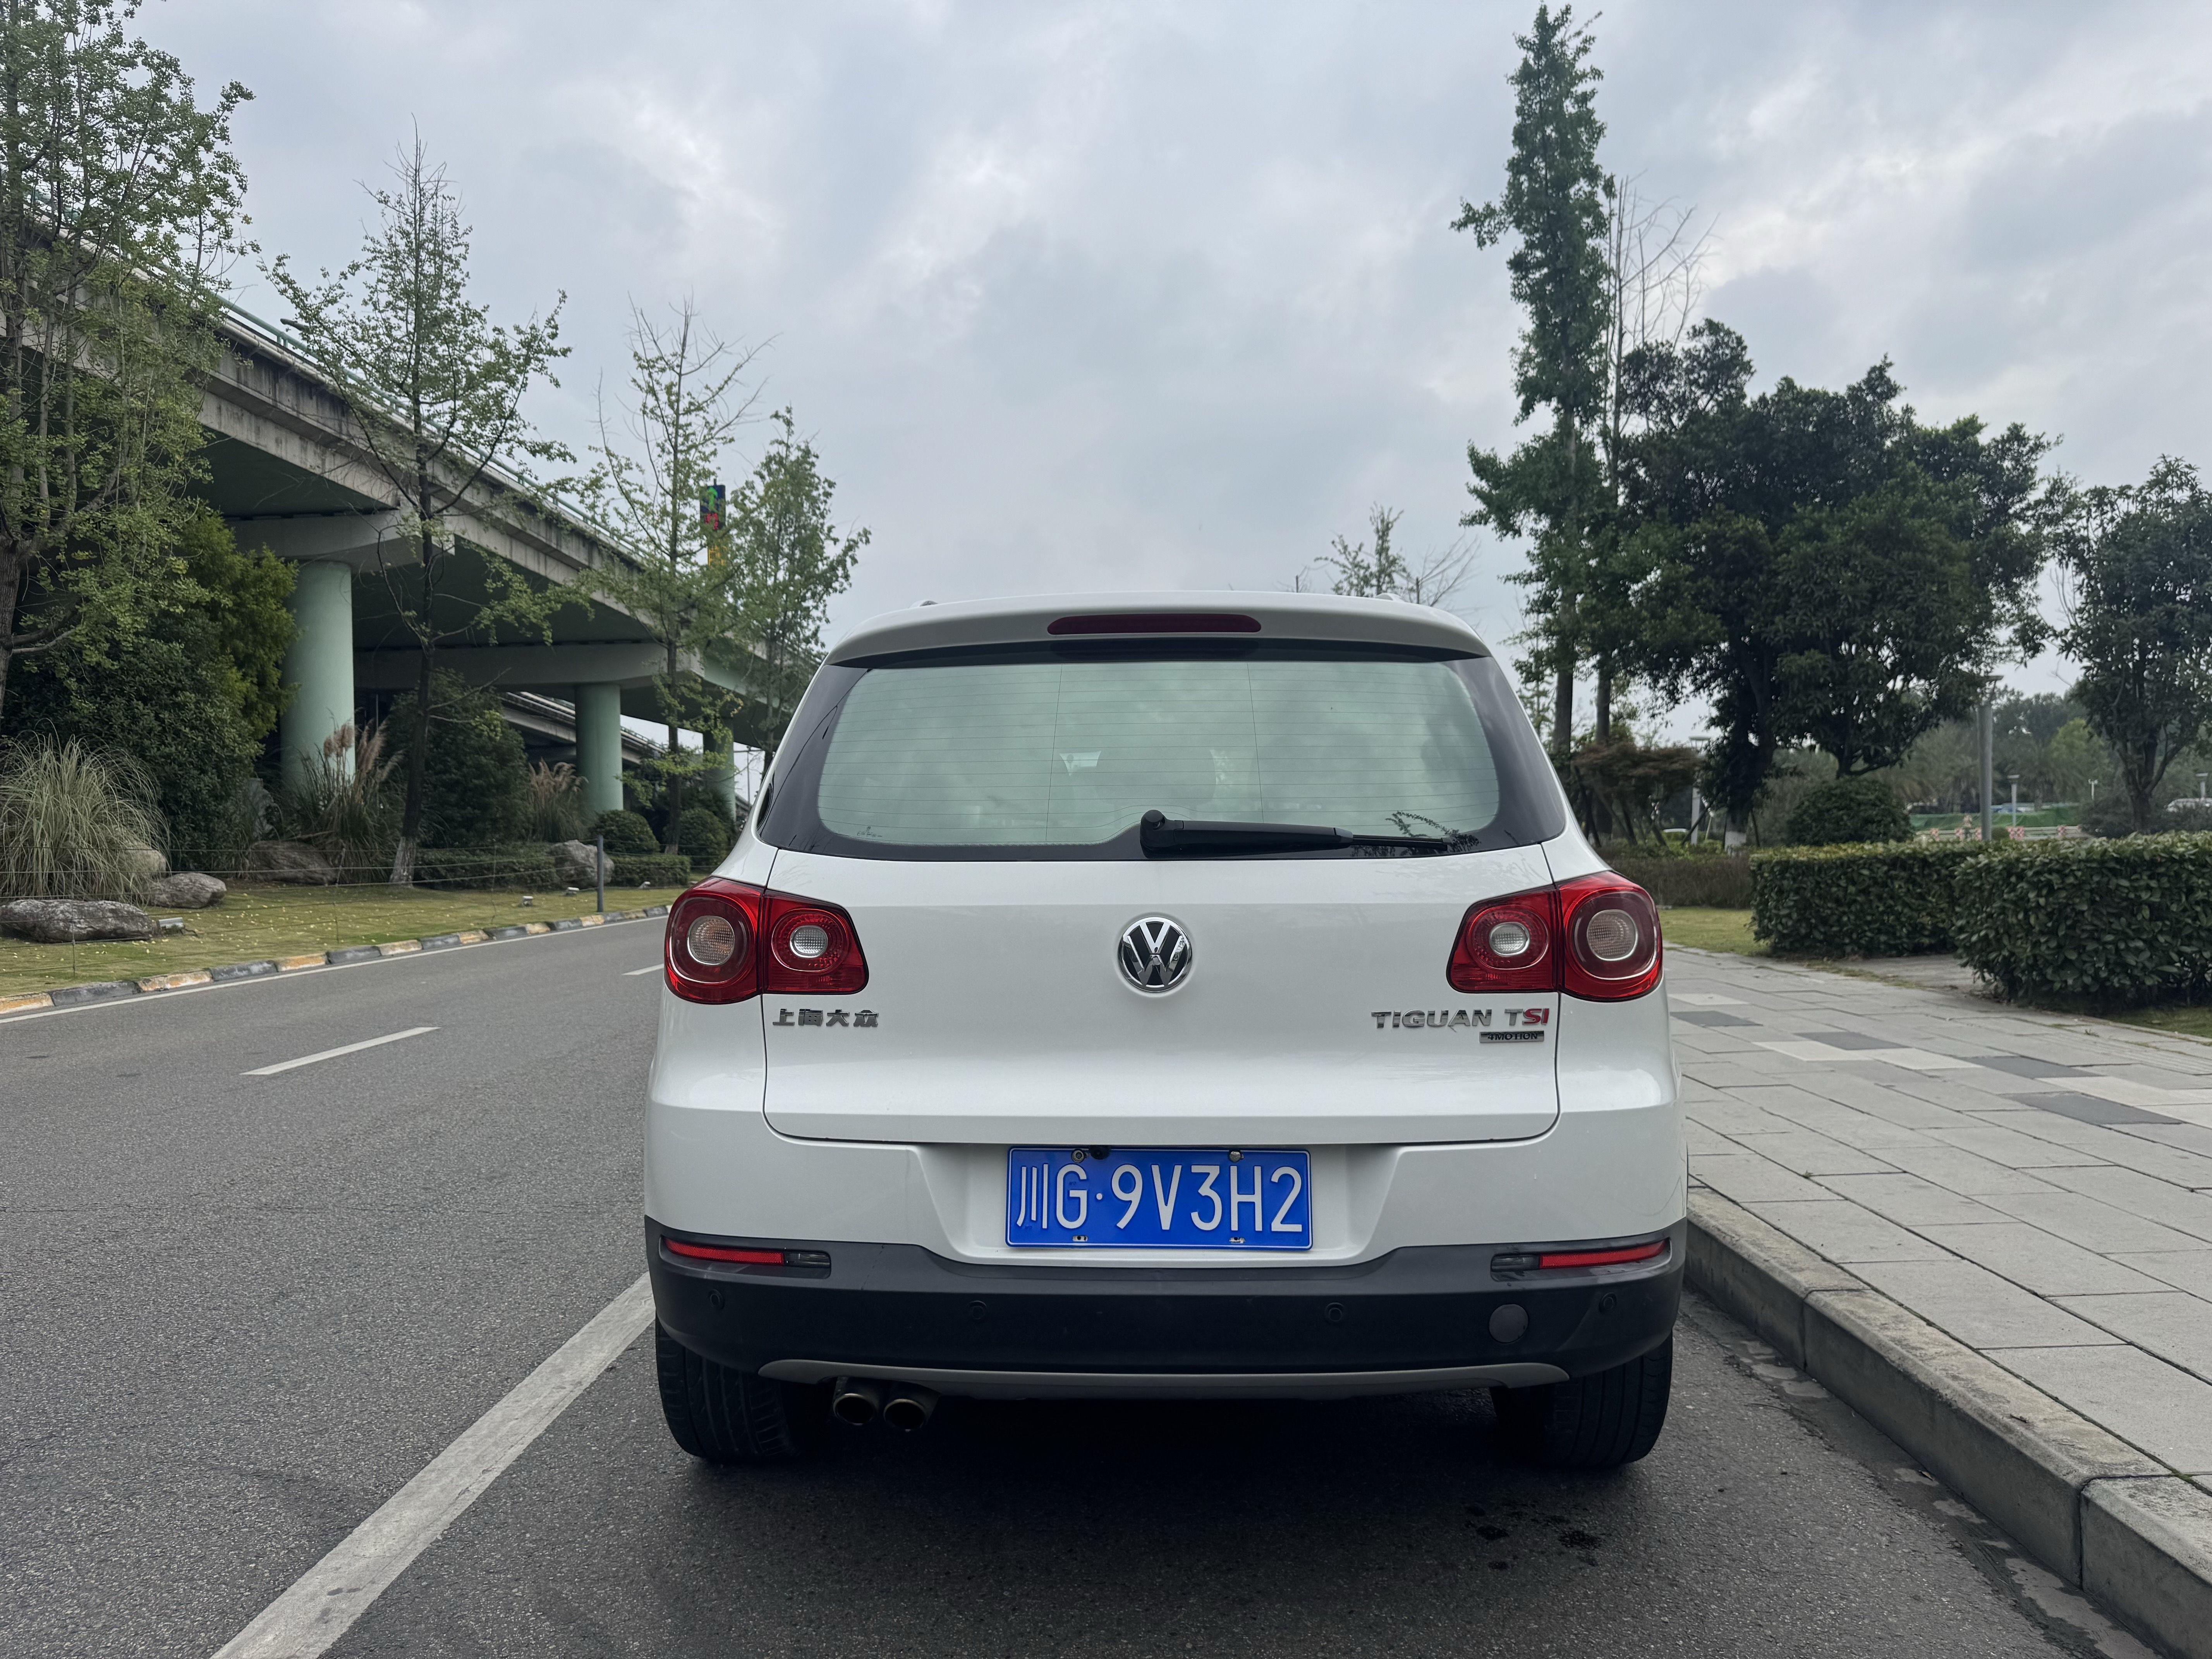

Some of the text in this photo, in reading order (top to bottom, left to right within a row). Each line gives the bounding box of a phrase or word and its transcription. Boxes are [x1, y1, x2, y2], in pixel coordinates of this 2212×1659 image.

[1120, 918, 1191, 991] VW
[773, 1008, 879, 1027] 上海大众
[1371, 1008, 1549, 1028] TIGUAN TSI
[1488, 1032, 1539, 1041] 4MOTION
[1017, 1164, 1303, 1232] 川G·9V3H2
